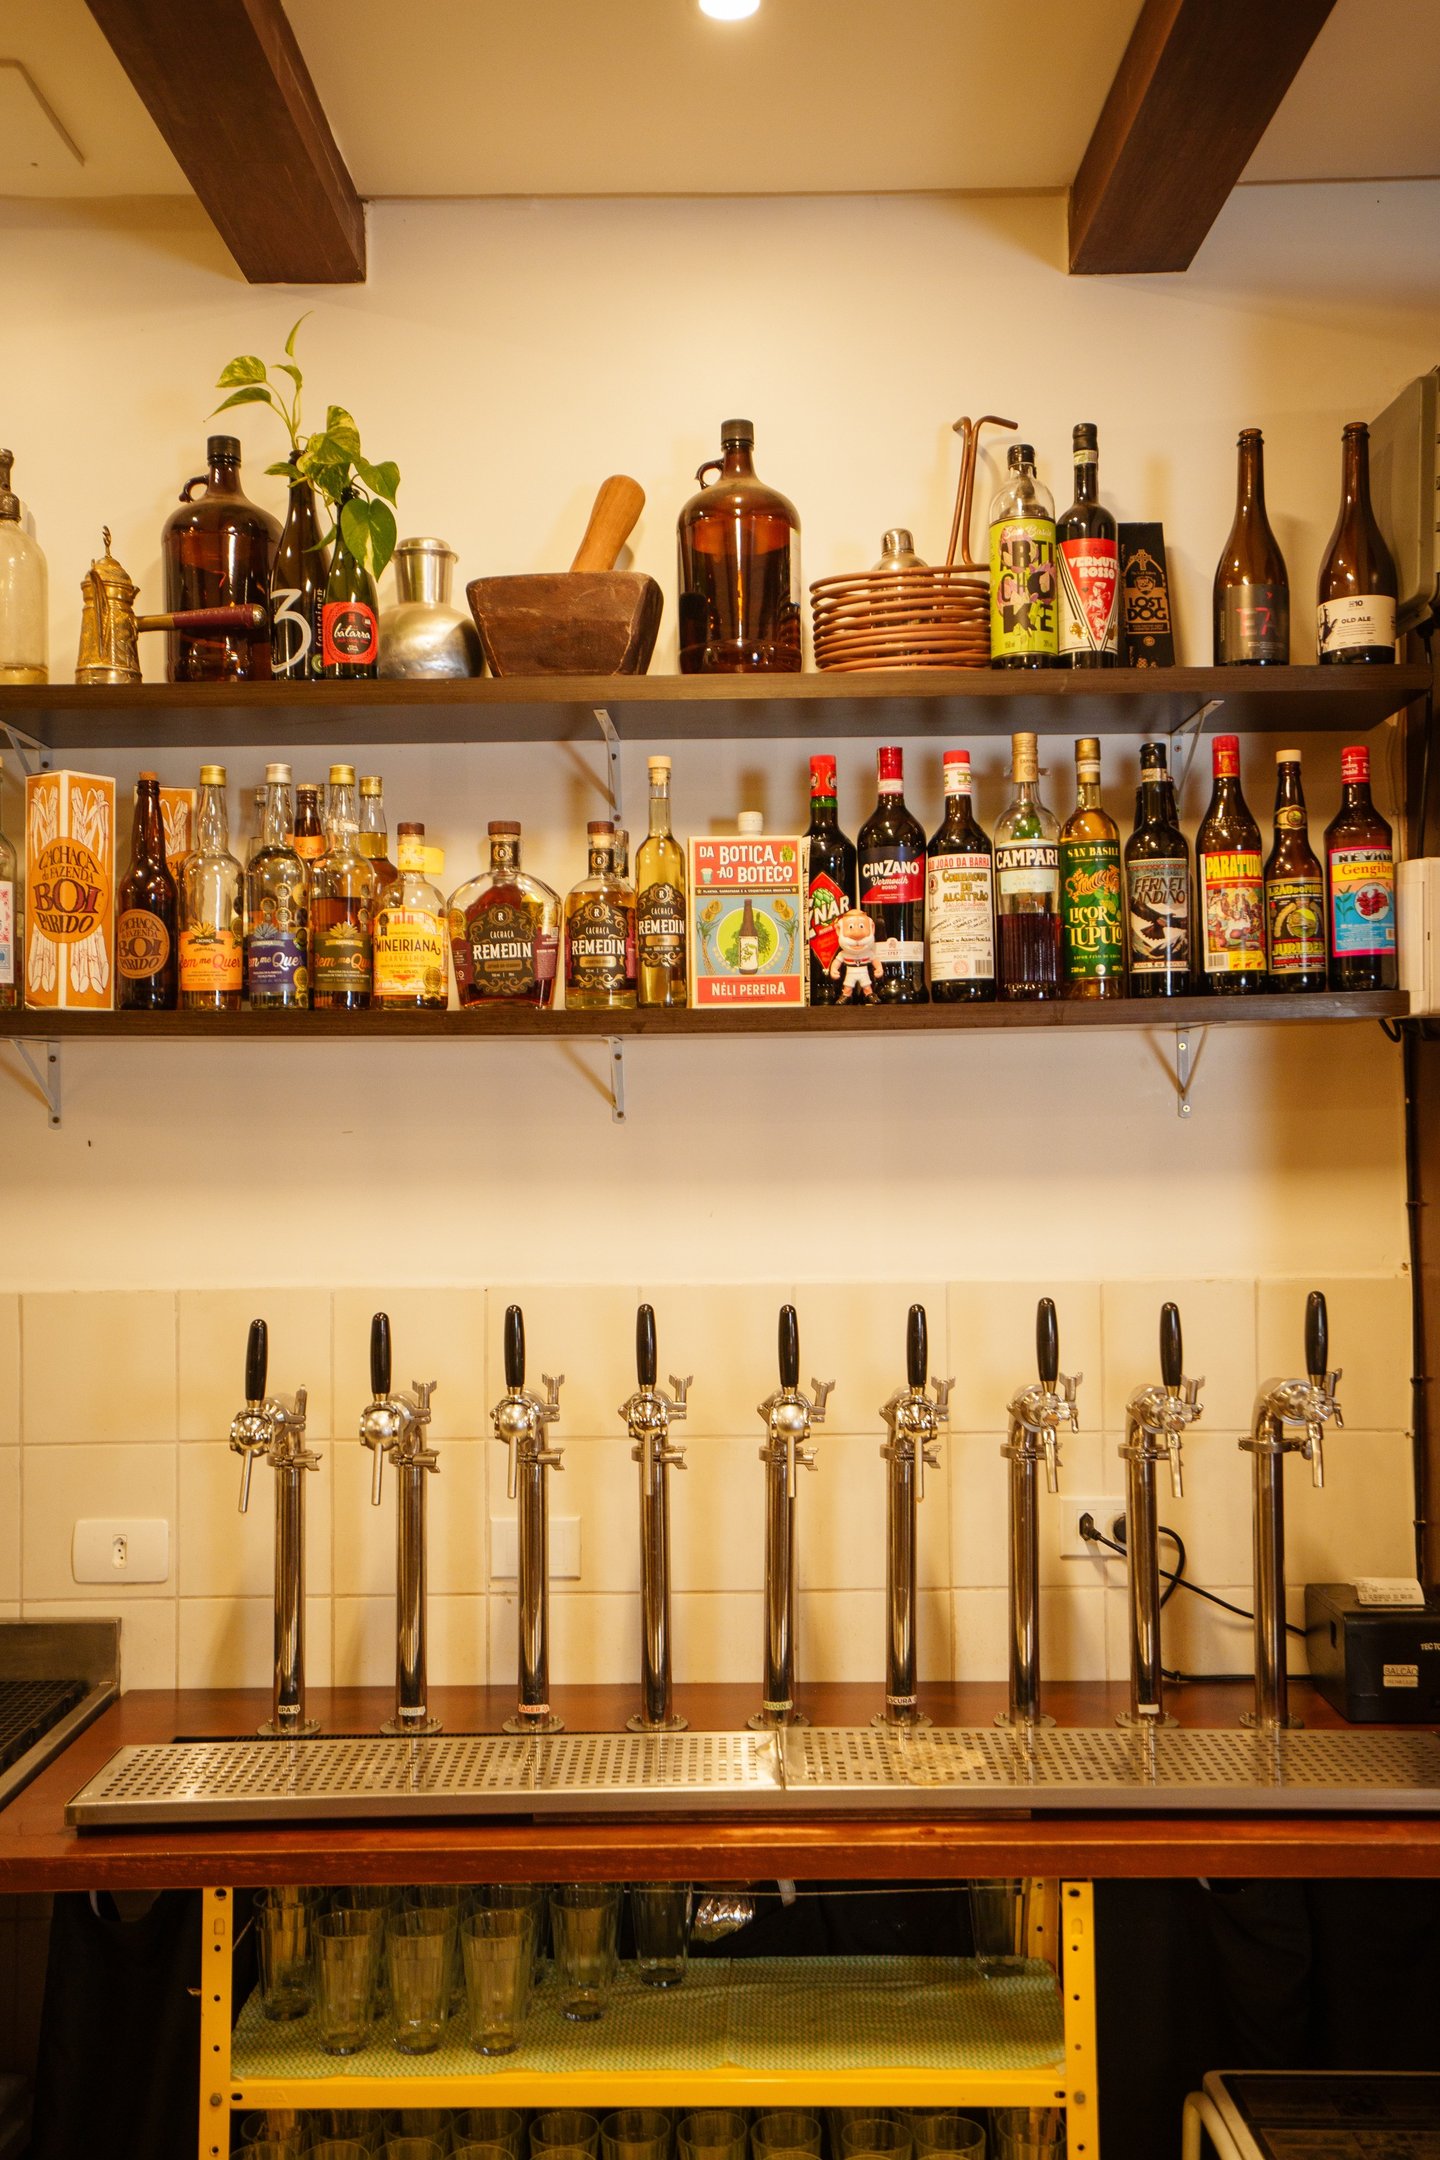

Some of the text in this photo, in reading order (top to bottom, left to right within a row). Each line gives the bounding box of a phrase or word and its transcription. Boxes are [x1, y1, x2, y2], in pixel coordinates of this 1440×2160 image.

[1080, 567, 1115, 580] ROSSO
[1129, 597, 1163, 608] LOST
[1003, 603, 1054, 634] KE
[1127, 607, 1167, 620] DOG
[271, 588, 312, 673] 3
[699, 844, 778, 865] DA BOTICA
[996, 848, 1058, 869] CAMPARI
[1067, 848, 1086, 858] SAN
[862, 859, 920, 878] CINZANO
[936, 857, 954, 869] JOÃO
[956, 857, 967, 867] DA
[969, 857, 990, 867] BARRA
[1341, 862, 1392, 876] Gengibr
[50, 864, 94, 883] FAZENDA
[717, 865, 793, 883] AO BOTECO
[871, 875, 909, 886] Vermouth
[1134, 877, 1185, 893] FERNET
[33, 878, 102, 914] BOI
[659, 890, 664, 898] R
[943, 890, 989, 902] ALCATRÃO
[1136, 890, 1185, 904] ANDINO
[498, 912, 504, 921] R
[594, 908, 600, 917] R
[1069, 906, 1120, 926] LICOR
[36, 912, 94, 934] PARIDO
[638, 919, 685, 935] REMEDIN
[119, 937, 162, 957] BOI
[473, 942, 532, 960] REMEDIN
[572, 939, 625, 955] REMEDIN
[711, 981, 786, 996] NÉLI PEREIRA
